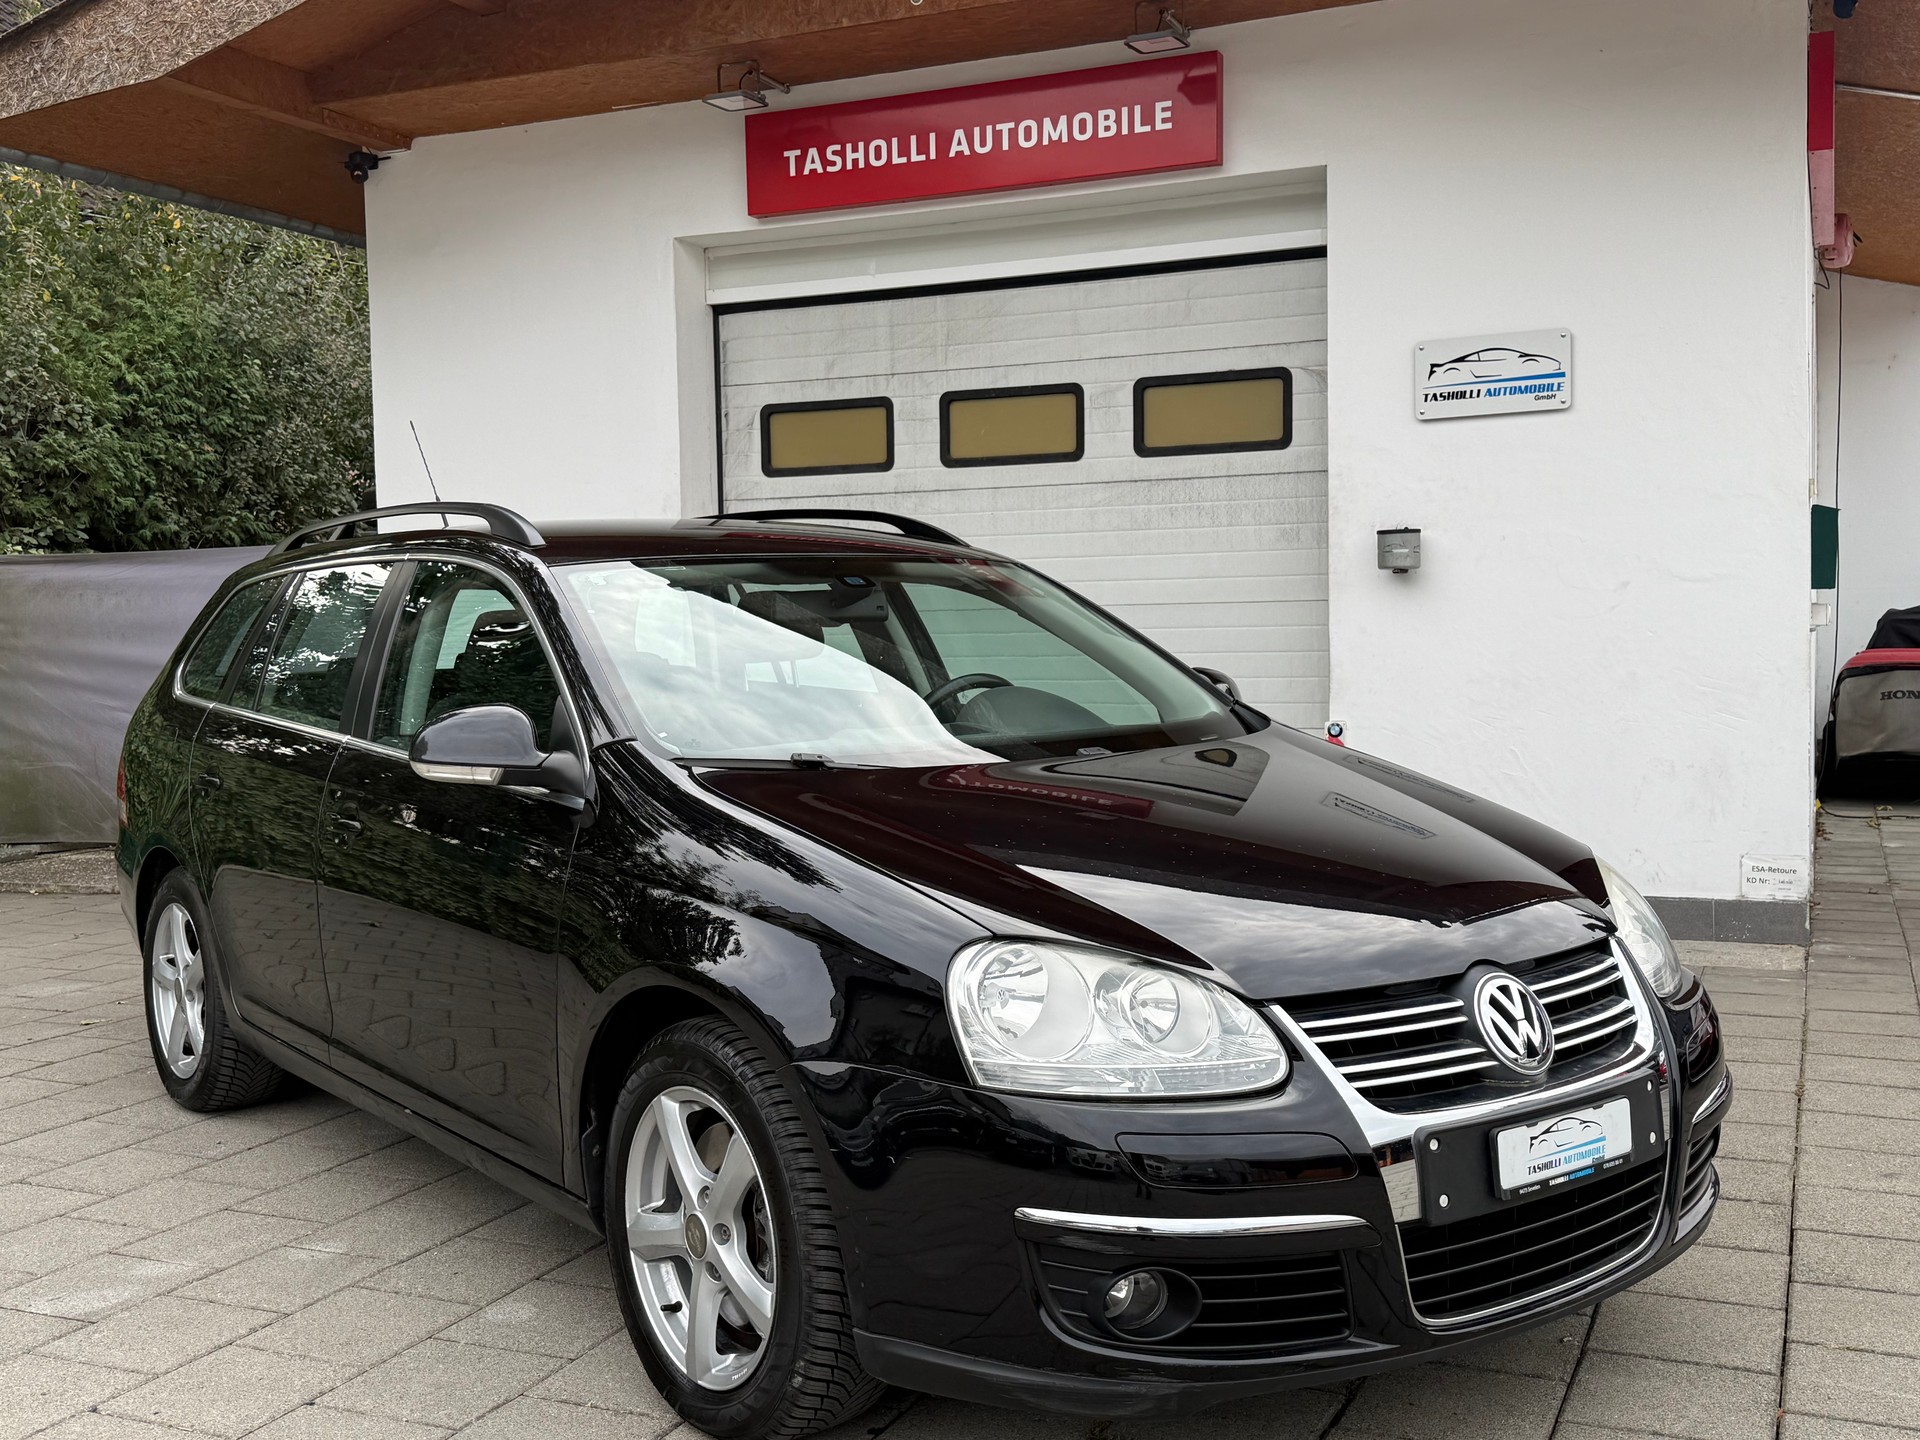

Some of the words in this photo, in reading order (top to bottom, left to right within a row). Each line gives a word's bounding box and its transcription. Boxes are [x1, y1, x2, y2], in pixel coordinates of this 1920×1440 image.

[783, 133, 936, 177] TASHOLLI
[949, 100, 1173, 158] AUTOMOBILE
[1422, 388, 1481, 403] TASHOLLI
[1484, 381, 1565, 399] AUTOMOBILE
[1534, 393, 1557, 402] GmbH
[1751, 865, 1797, 875] ESA-Retoure
[1527, 1158, 1561, 1176] TASHOLLI
[1562, 1144, 1606, 1166] AUTOMOBILE
